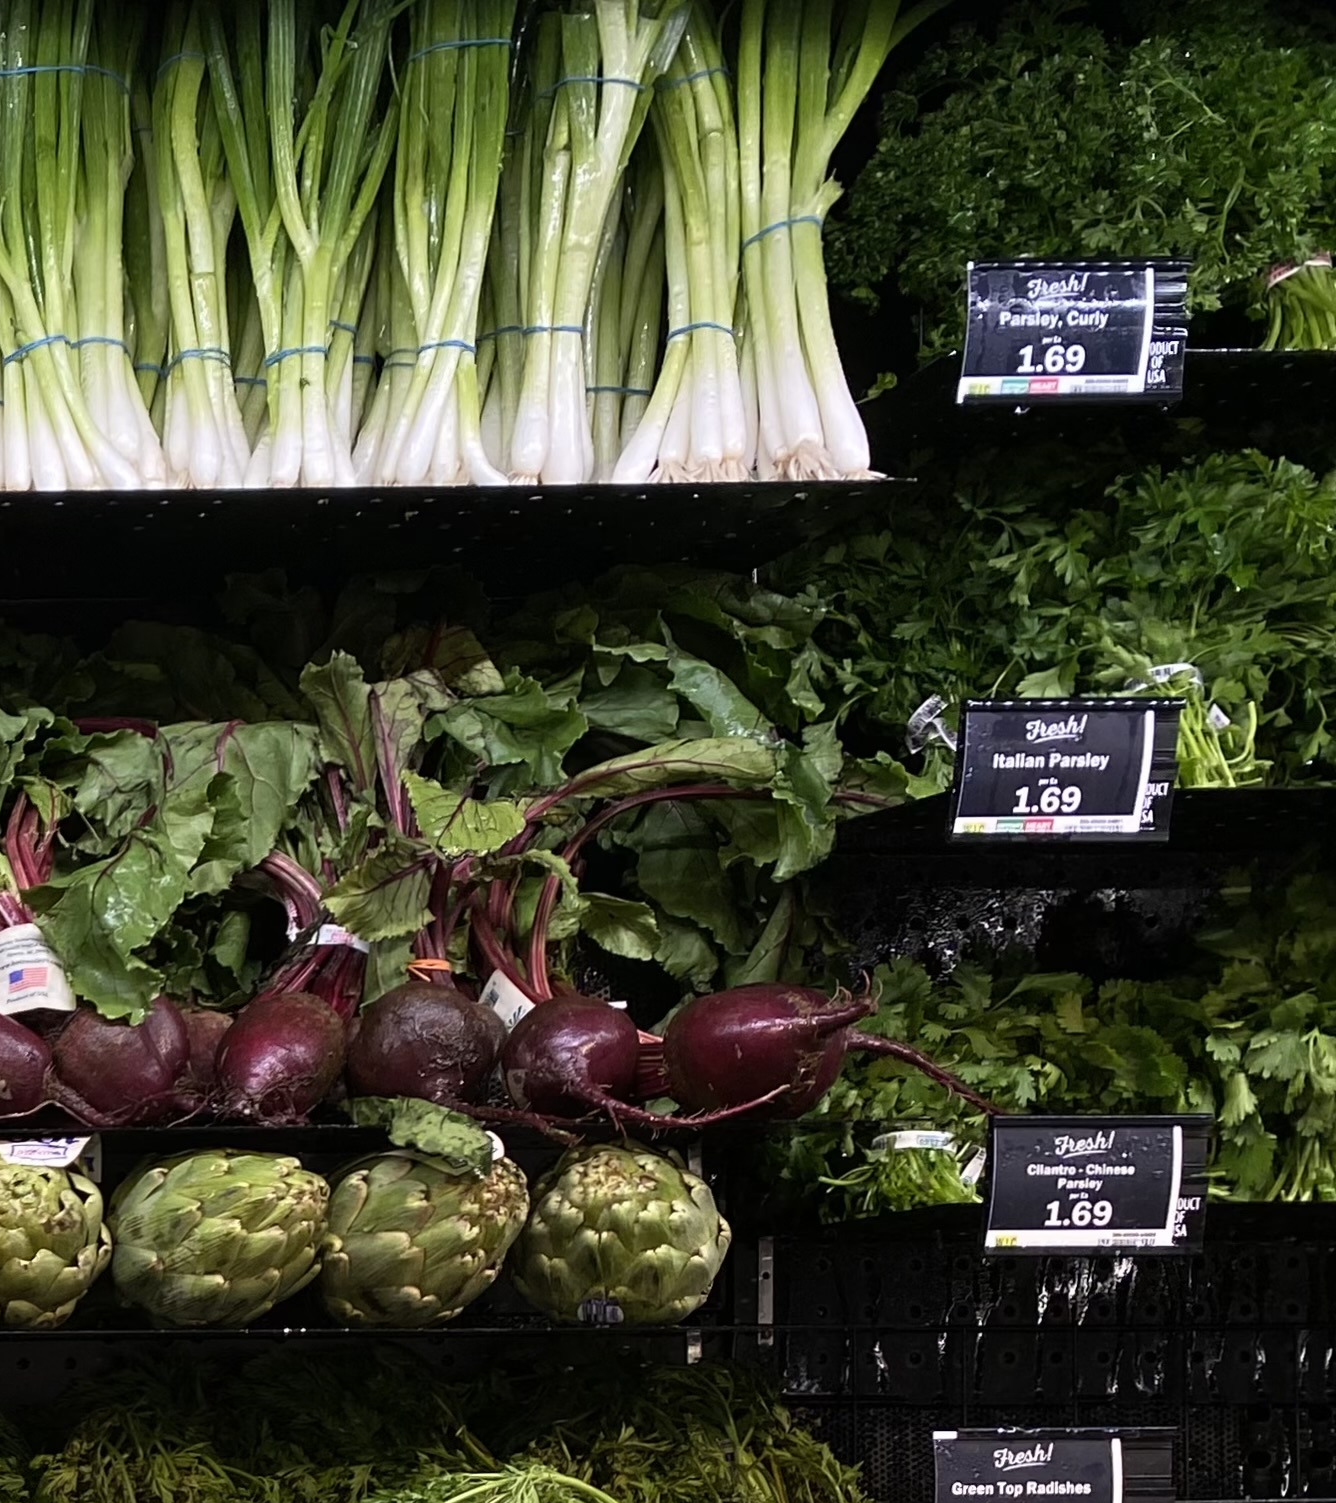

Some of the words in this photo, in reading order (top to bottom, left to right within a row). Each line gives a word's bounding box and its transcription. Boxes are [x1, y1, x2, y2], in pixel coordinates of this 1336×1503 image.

[1027, 273, 1089, 300] Fresh!
[999, 311, 1063, 329] Parsley,
[1066, 311, 1109, 327] Curly
[1149, 341, 1179, 355] ODUCT
[1016, 344, 1086, 373] 1.69
[1151, 355, 1163, 369] OF
[1147, 370, 1166, 383] USA
[1025, 714, 1088, 741] Fresh!
[993, 753, 1045, 769] Italian
[1049, 753, 1110, 770] Parsley
[1012, 786, 1081, 813] 1.69
[1140, 810, 1154, 823] SA
[1054, 1131, 1115, 1155] Fresh!
[1027, 1163, 1076, 1176] Cilantro
[1085, 1163, 1135, 1176] Chinese
[1057, 1178, 1103, 1191] Parsley
[1043, 1200, 1113, 1227] 1.69
[993, 1442, 1054, 1468] Fresh!
[951, 1481, 994, 1496] Green
[996, 1481, 1023, 1497] Top
[1026, 1481, 1091, 1495] Radishes
